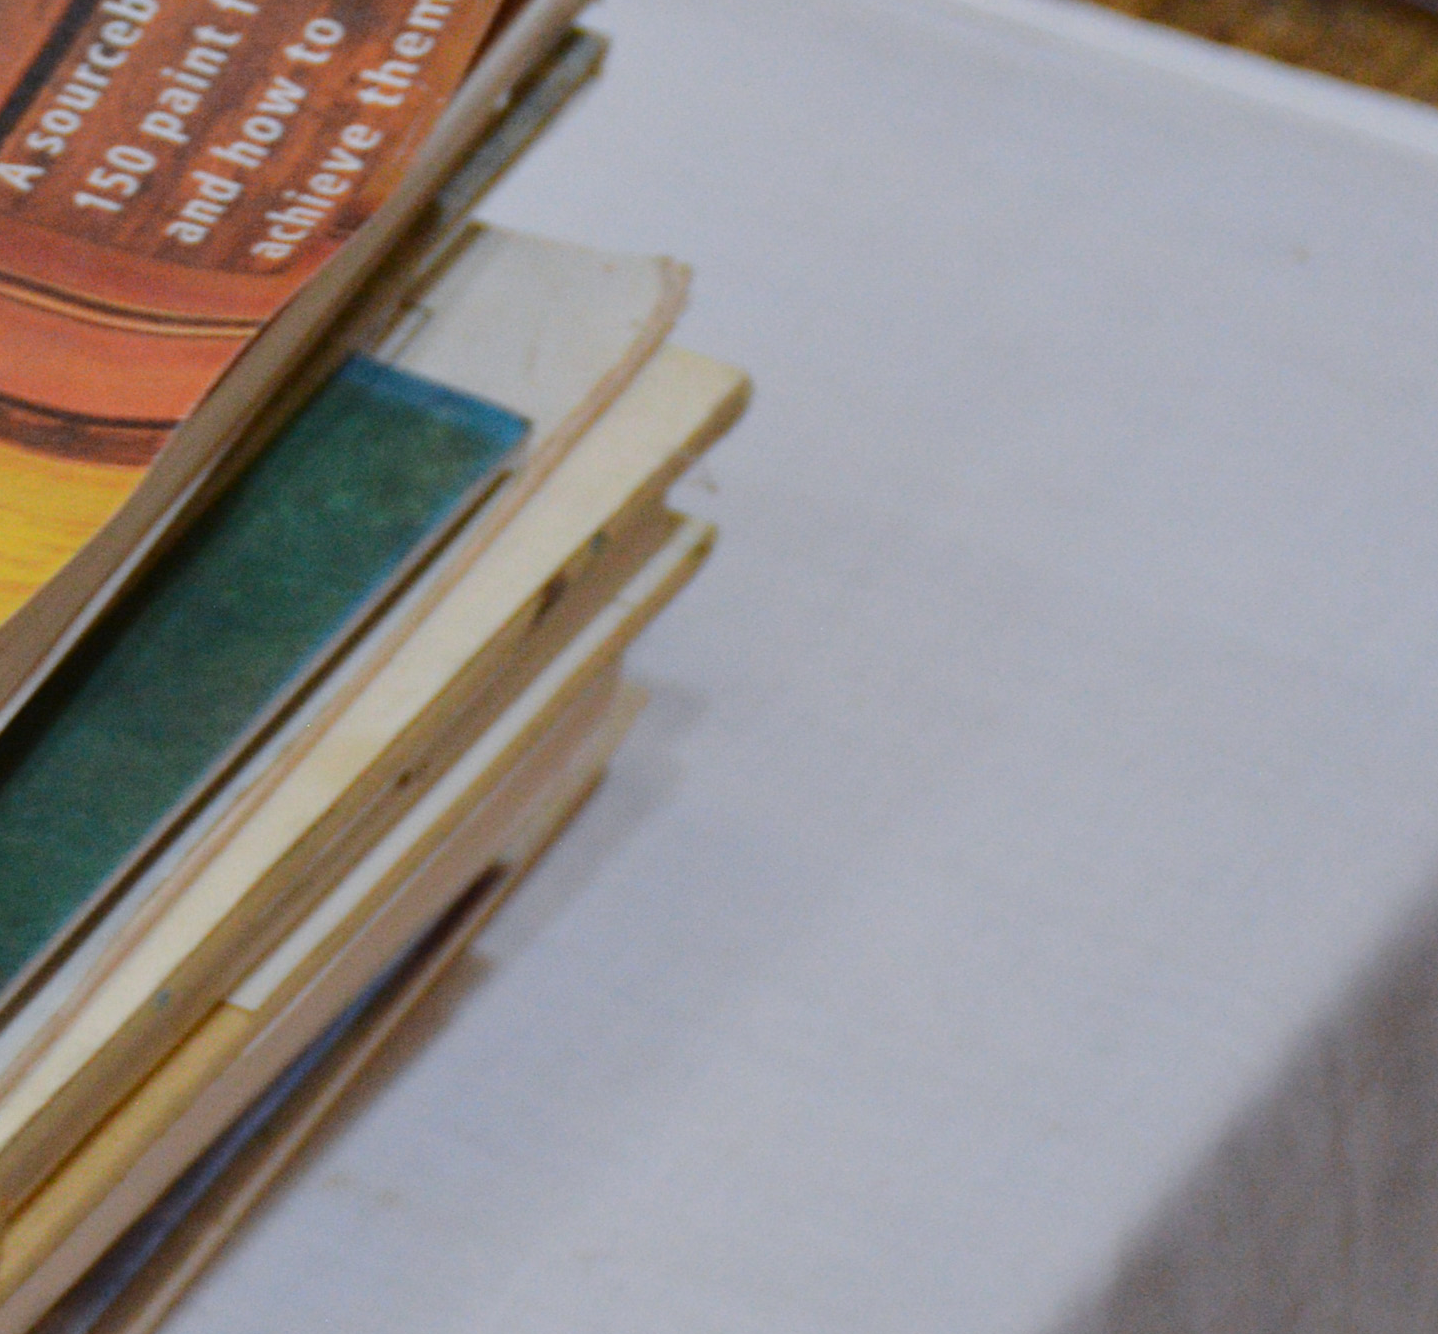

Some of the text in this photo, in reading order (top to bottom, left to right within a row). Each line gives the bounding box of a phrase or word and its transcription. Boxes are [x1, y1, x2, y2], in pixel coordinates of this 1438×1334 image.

[74, 144, 157, 213] 150
[141, 24, 241, 144] paint
[165, 17, 344, 244] and how to
[250, 122, 381, 259] achieve
